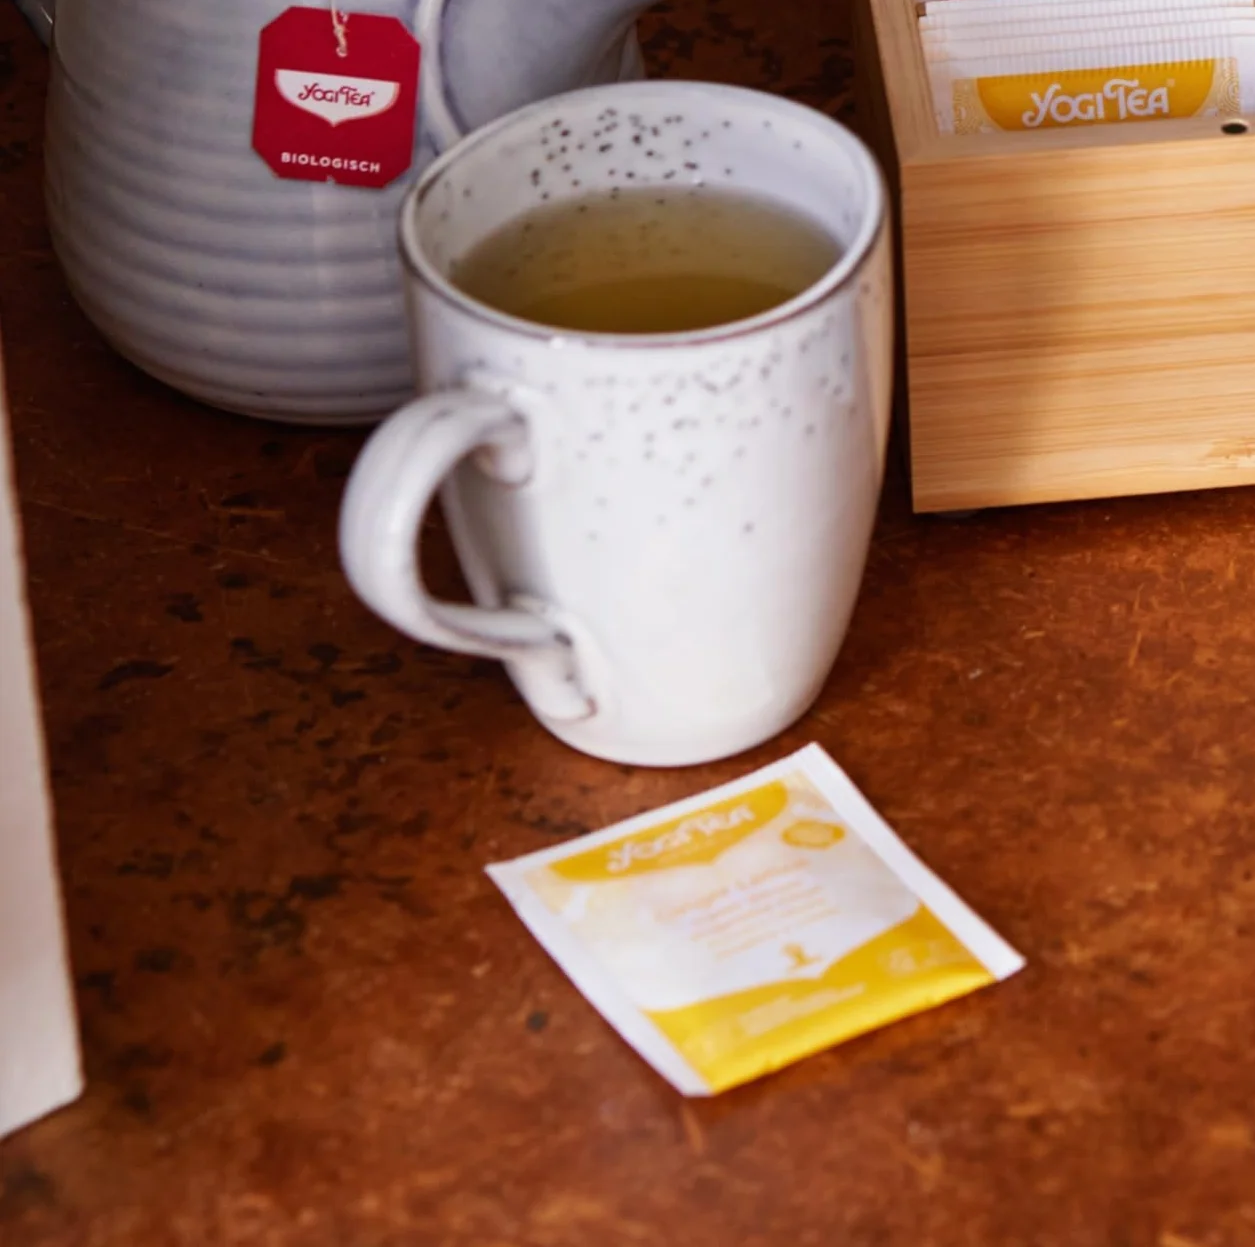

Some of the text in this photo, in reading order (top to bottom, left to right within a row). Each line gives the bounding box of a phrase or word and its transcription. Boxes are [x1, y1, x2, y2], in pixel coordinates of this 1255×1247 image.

[297, 82, 339, 103] YOGI
[1021, 83, 1105, 128] YOGI
[280, 151, 382, 173] BIOLOGISCH
